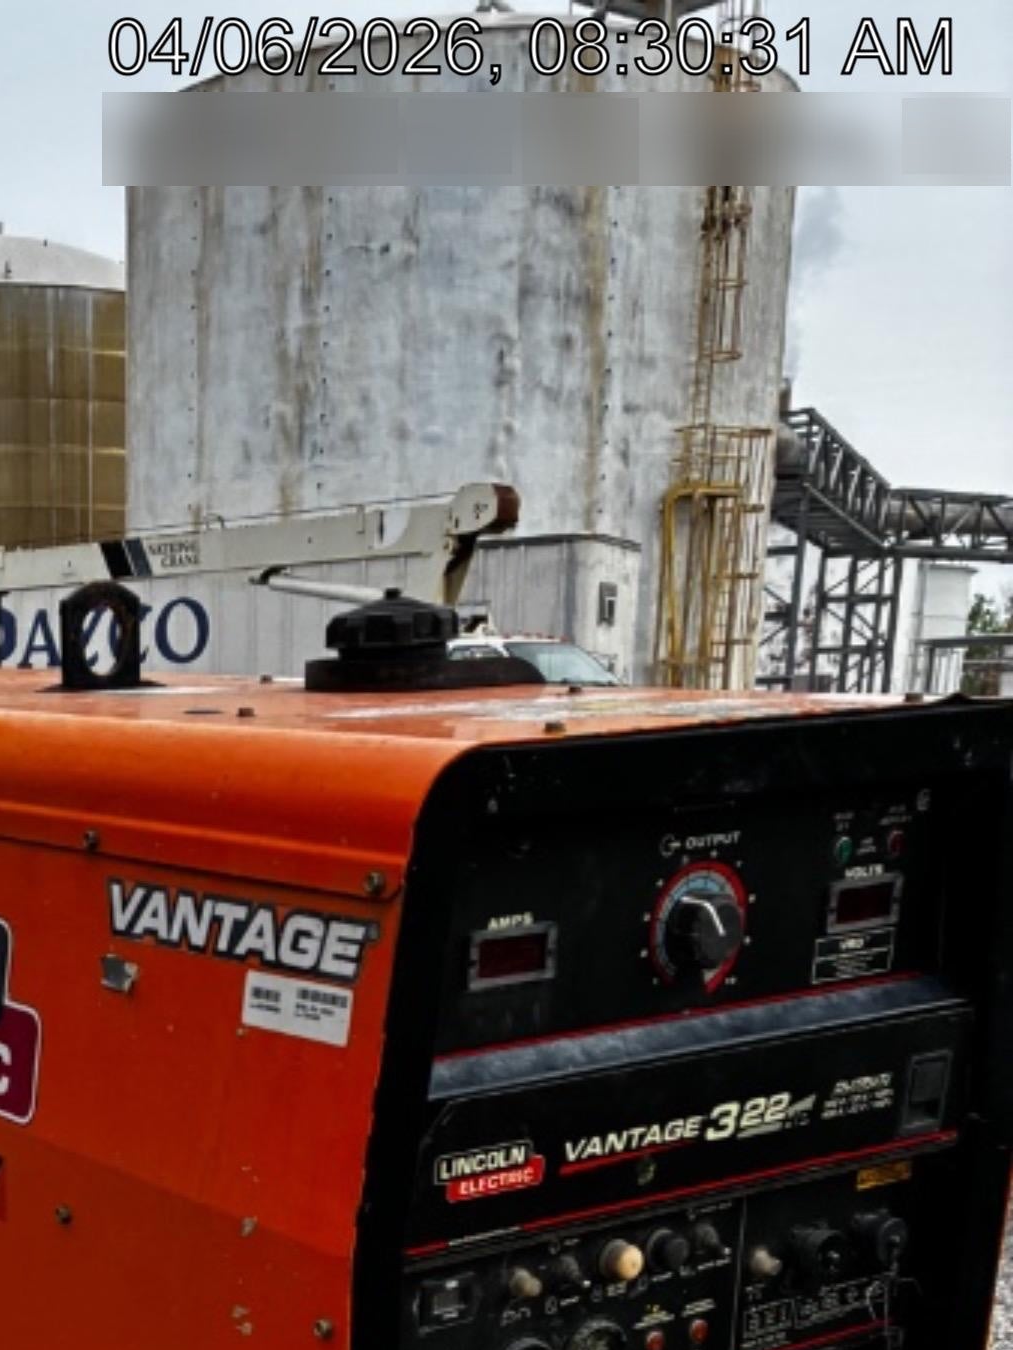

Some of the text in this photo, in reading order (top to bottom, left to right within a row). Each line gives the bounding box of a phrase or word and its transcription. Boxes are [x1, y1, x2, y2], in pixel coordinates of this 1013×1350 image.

[685, 832, 741, 849] OUTPUT
[109, 881, 367, 979] VANTAGE
[488, 912, 534, 931] AMPS
[564, 1115, 703, 1163] VANTAGE
[704, 1091, 793, 1143] 322
[439, 1145, 527, 1180] LINCOLN
[459, 1166, 536, 1196] ELECTRIC
